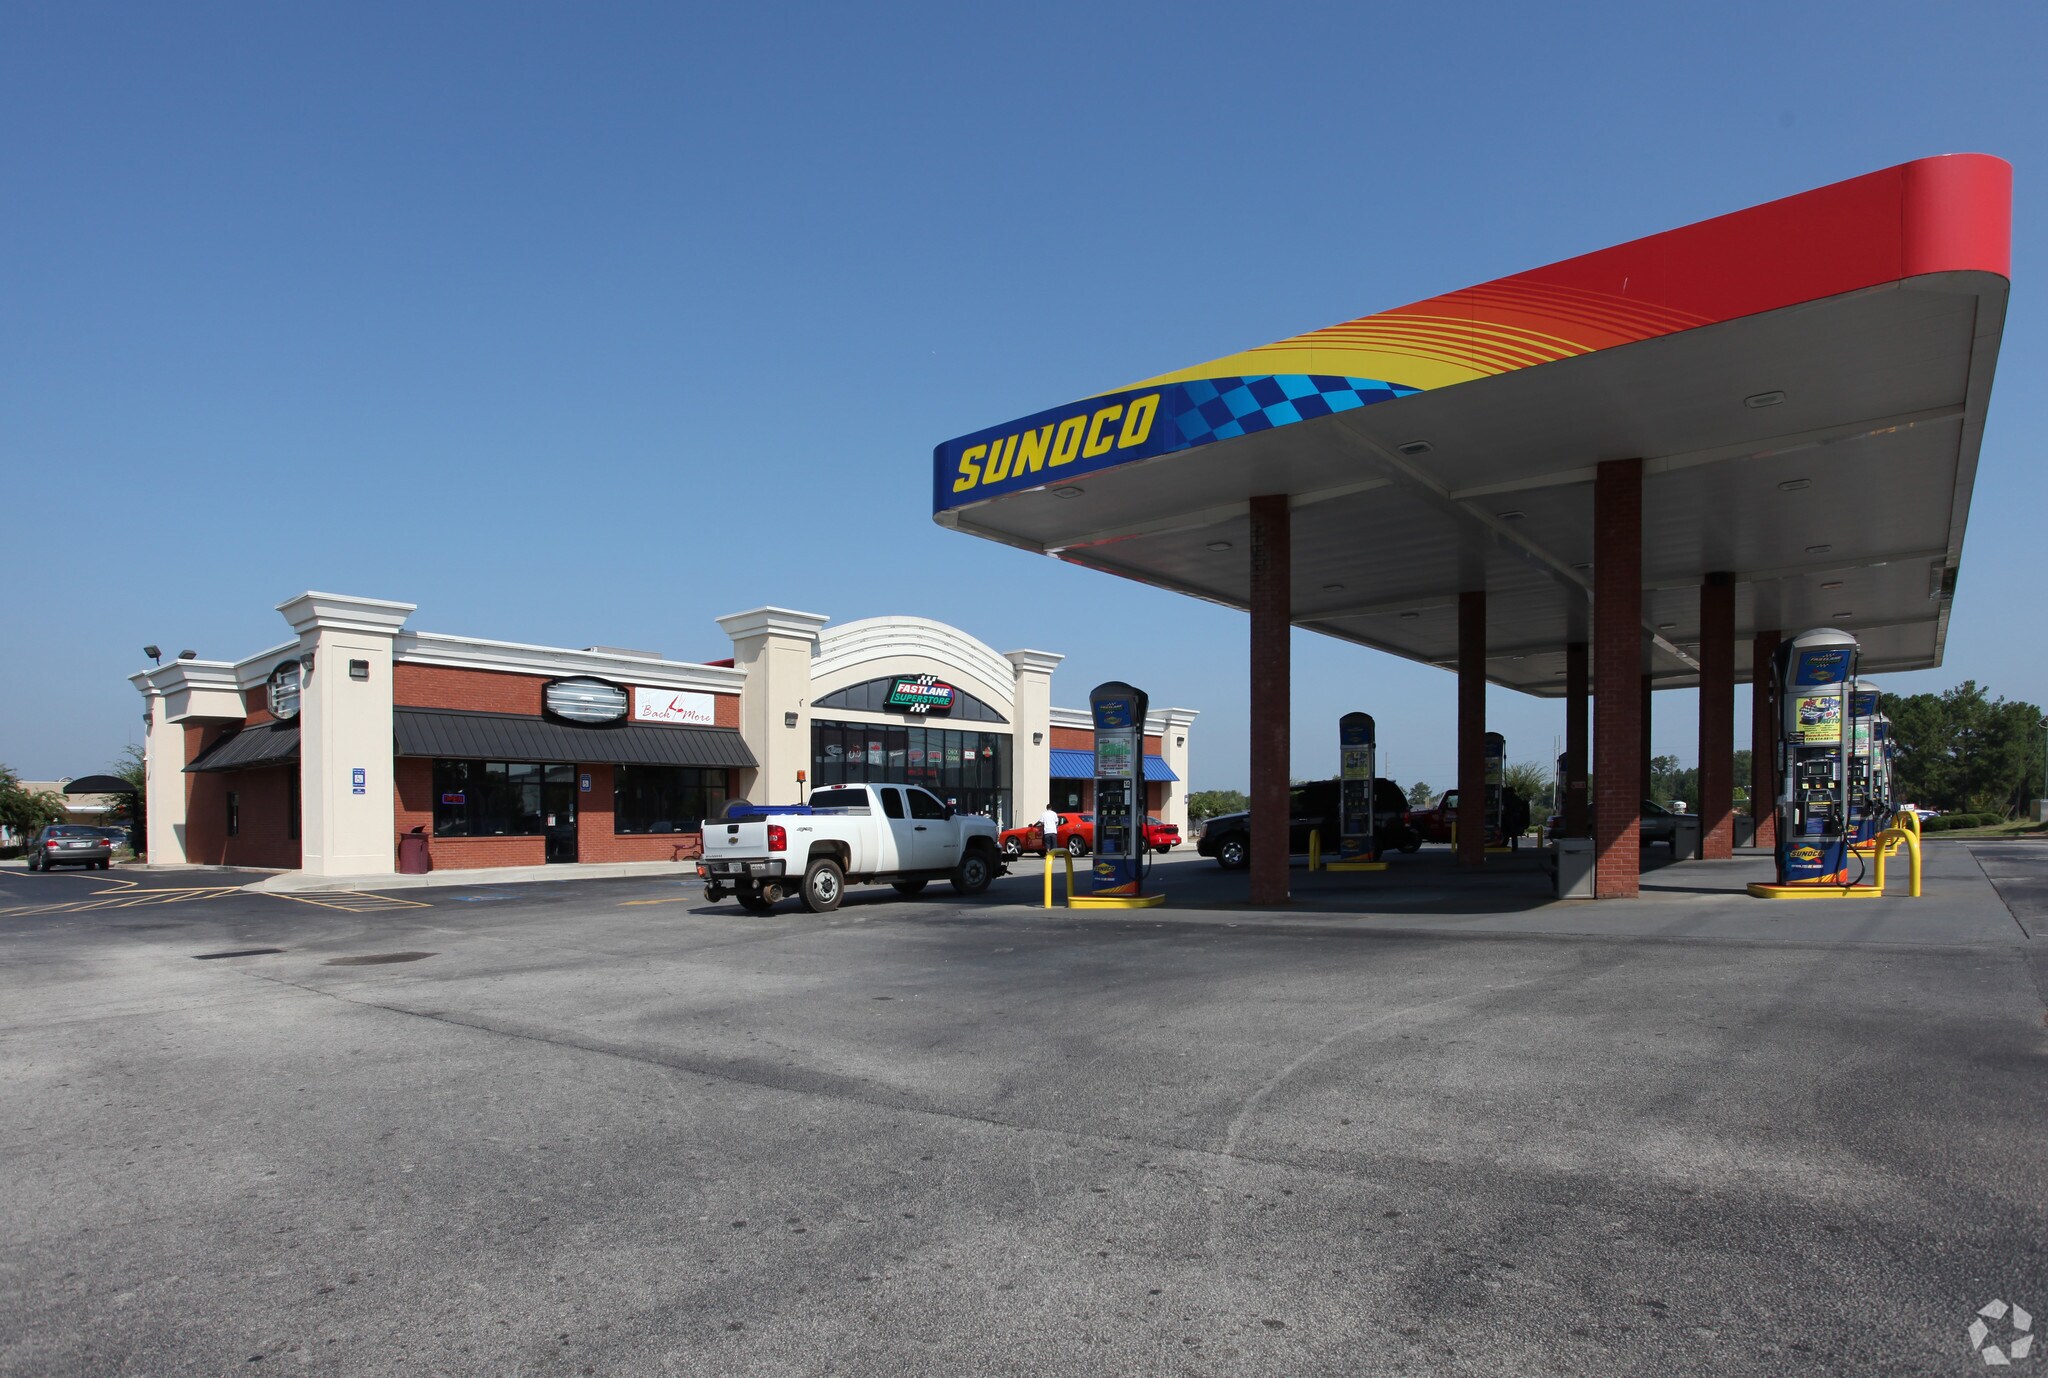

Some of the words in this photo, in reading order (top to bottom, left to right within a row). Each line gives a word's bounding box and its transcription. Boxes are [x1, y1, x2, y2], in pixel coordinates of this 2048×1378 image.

[952, 393, 1161, 493] SUNOCO
[896, 683, 950, 697] FASTLANE
[894, 693, 951, 705] SUPERSTORE
[642, 704, 671, 719] Back
[683, 710, 711, 722] More
